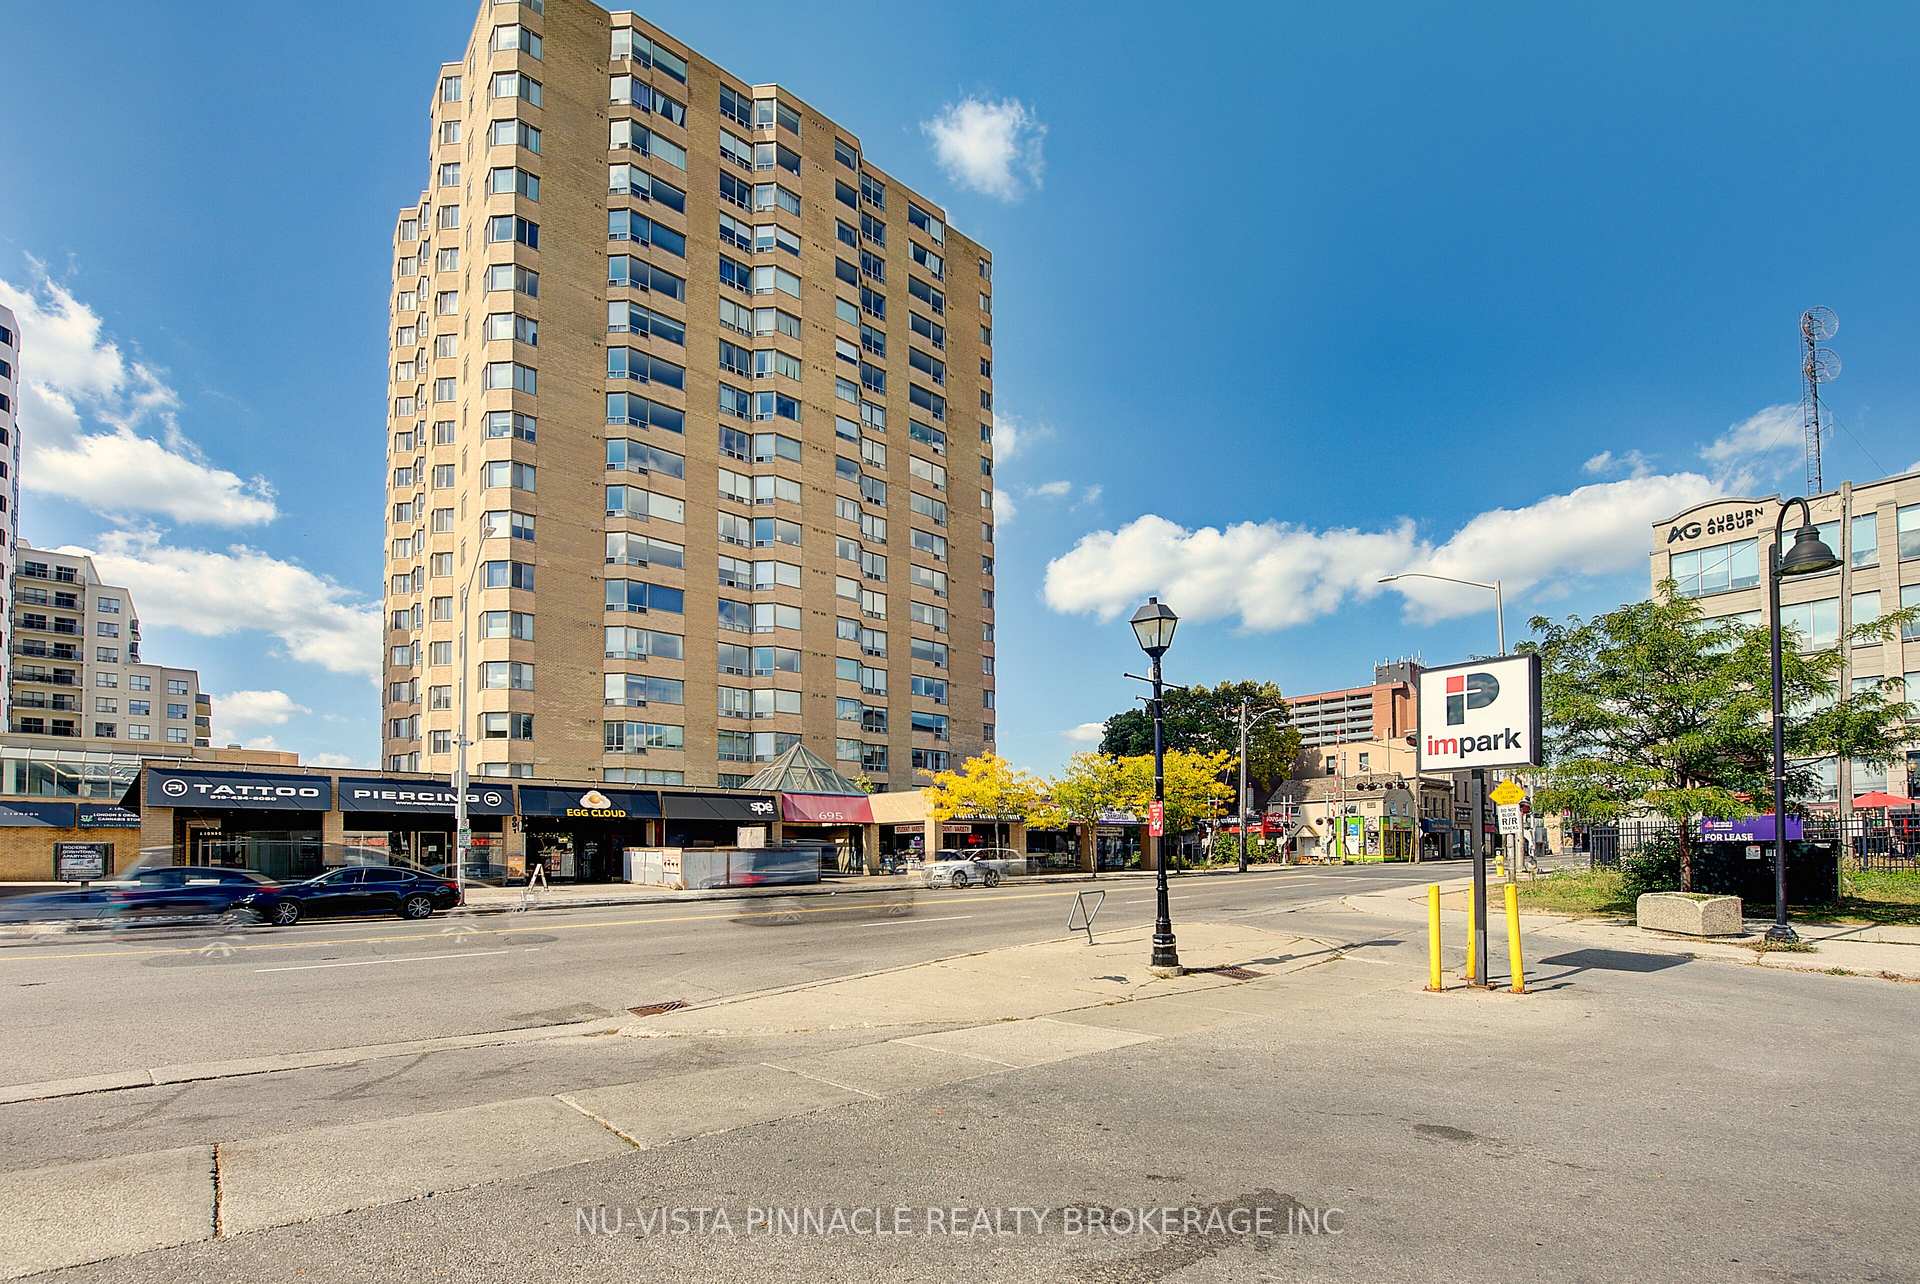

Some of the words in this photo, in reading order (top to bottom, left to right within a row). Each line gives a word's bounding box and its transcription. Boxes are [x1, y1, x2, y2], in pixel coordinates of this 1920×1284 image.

[1707, 507, 1764, 527] AUBURN
[1707, 519, 1754, 535] GROUP
[1427, 728, 1521, 758] impark
[193, 784, 320, 797] TATTOO
[354, 790, 480, 803] PIERCING
[566, 808, 589, 818] EGG
[591, 809, 626, 818] CLOUD
[818, 811, 844, 821] 695
[1502, 817, 1518, 826] R/R
[1704, 833, 1723, 841] FOR
[1724, 833, 1754, 841] LEASE
